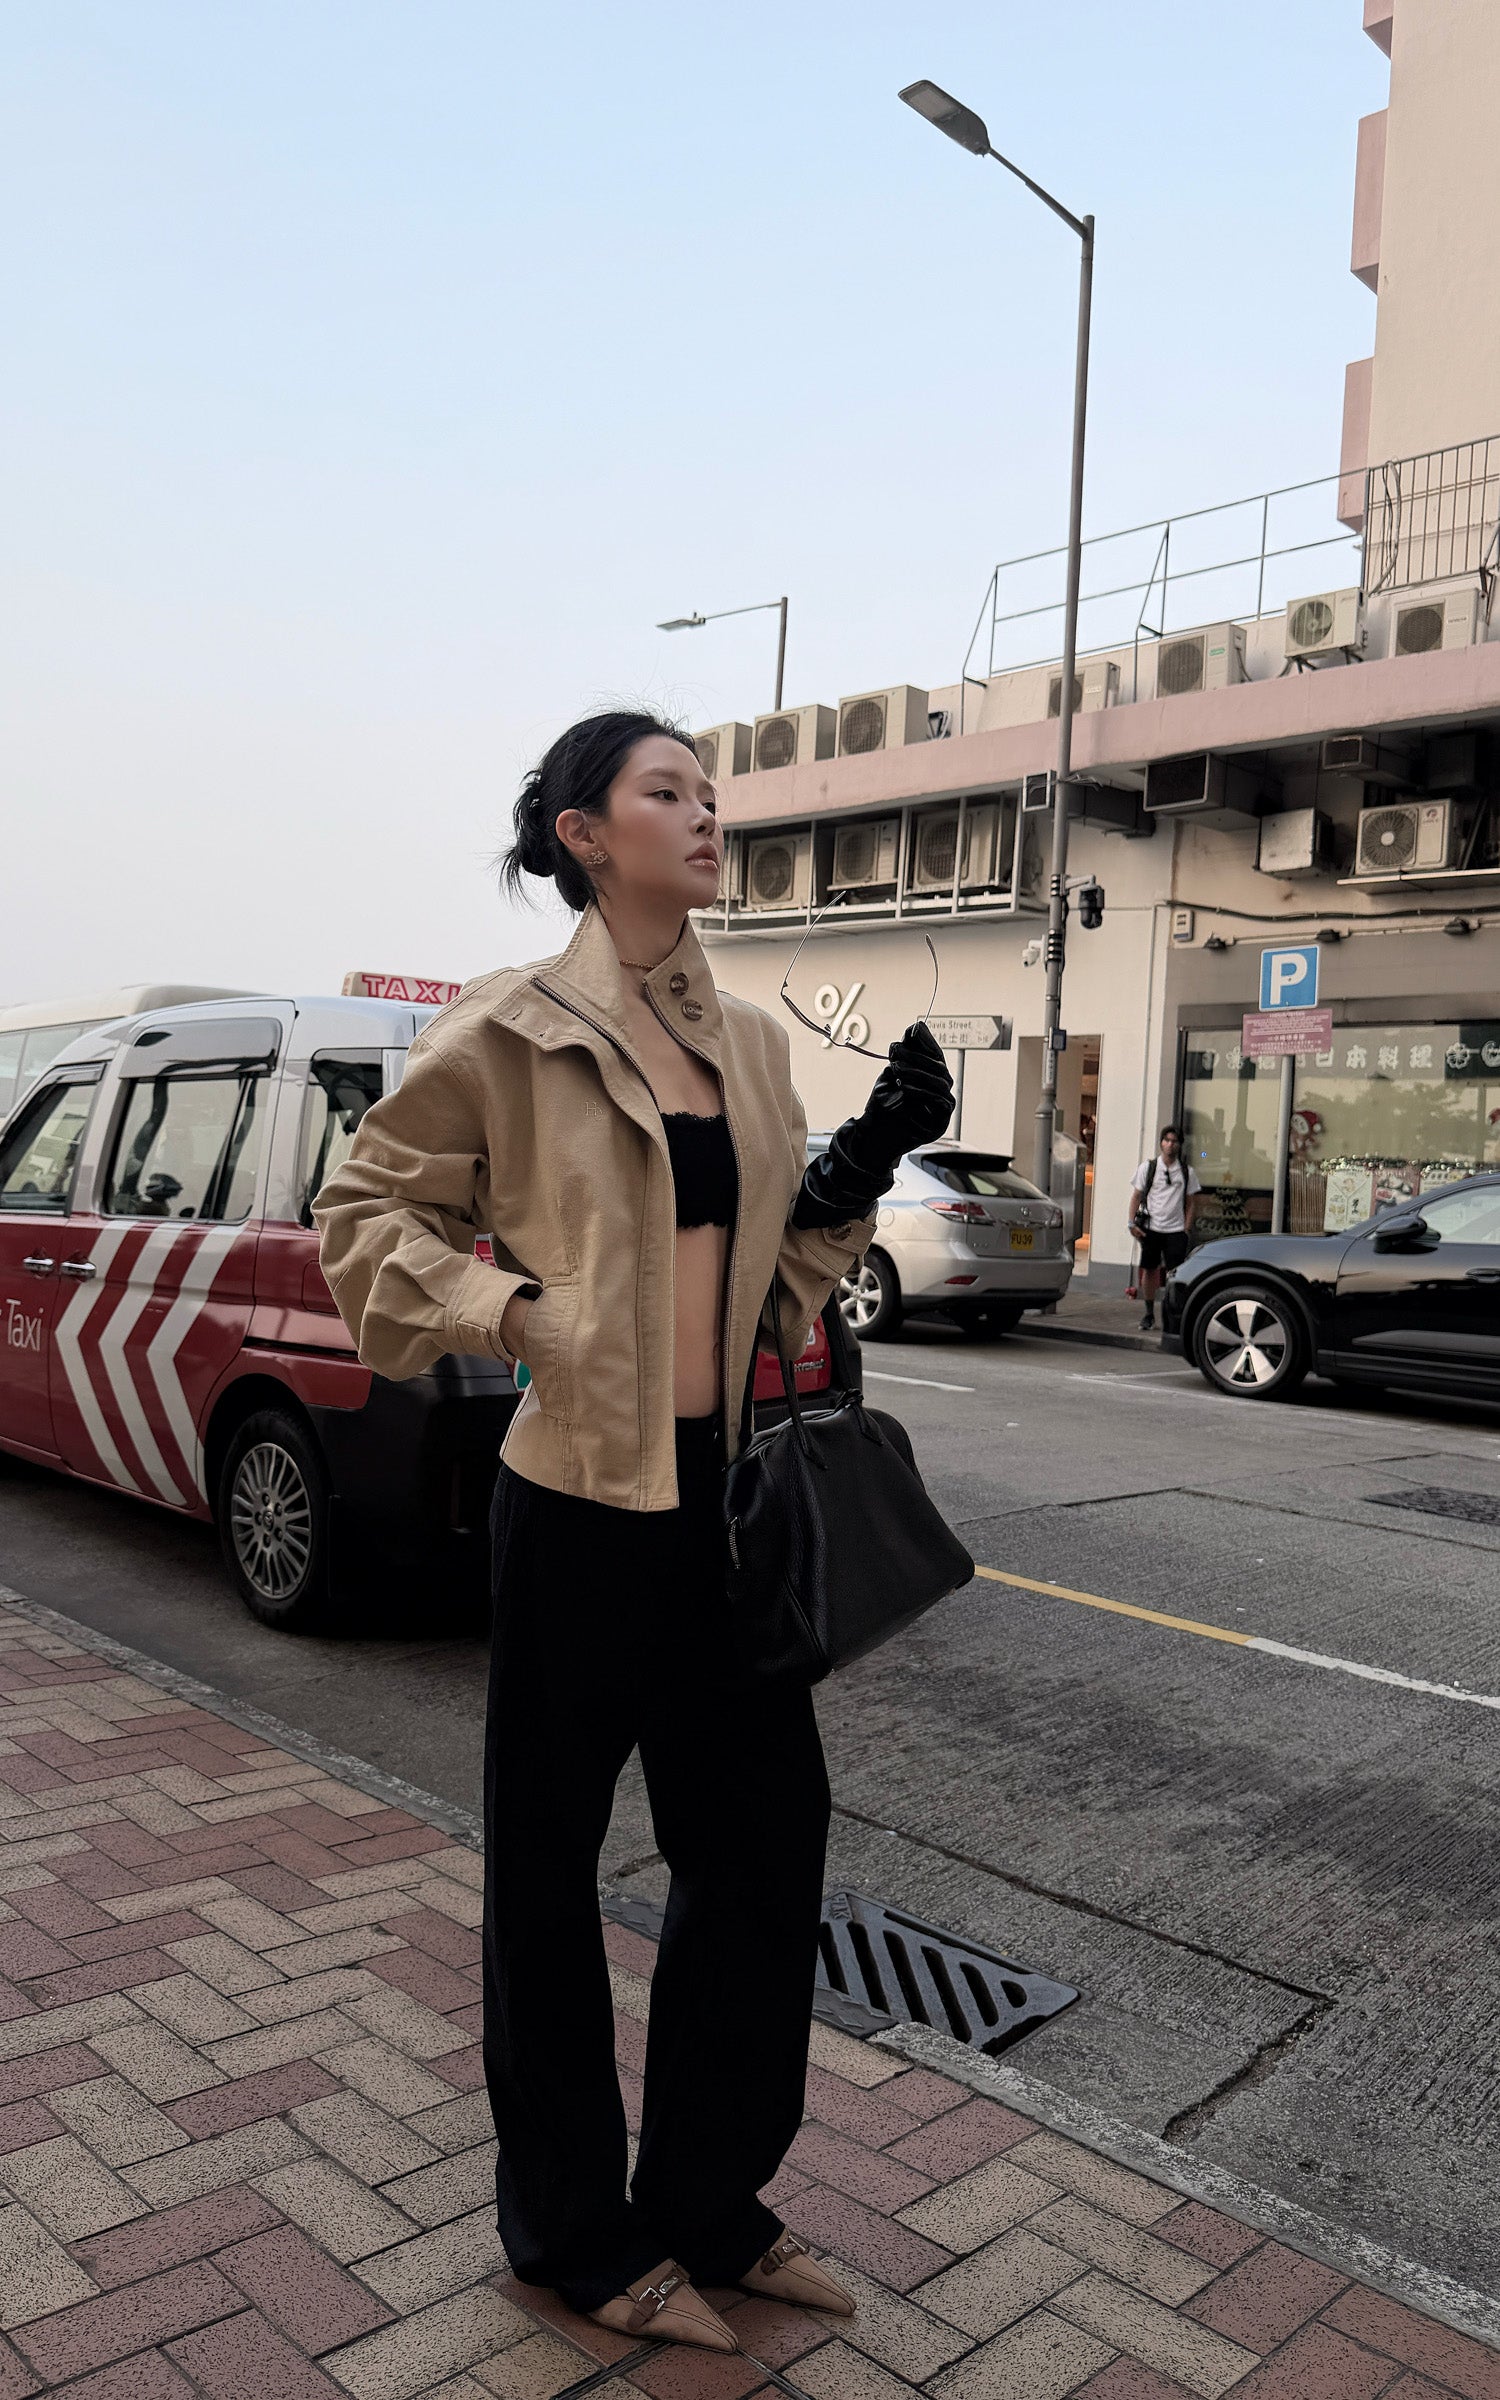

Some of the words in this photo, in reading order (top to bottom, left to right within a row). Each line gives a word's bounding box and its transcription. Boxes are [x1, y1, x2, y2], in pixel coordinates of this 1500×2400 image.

[362, 974, 461, 1005] TAXI
[1270, 953, 1308, 1005] P
[6, 1298, 44, 1352] Taxi
